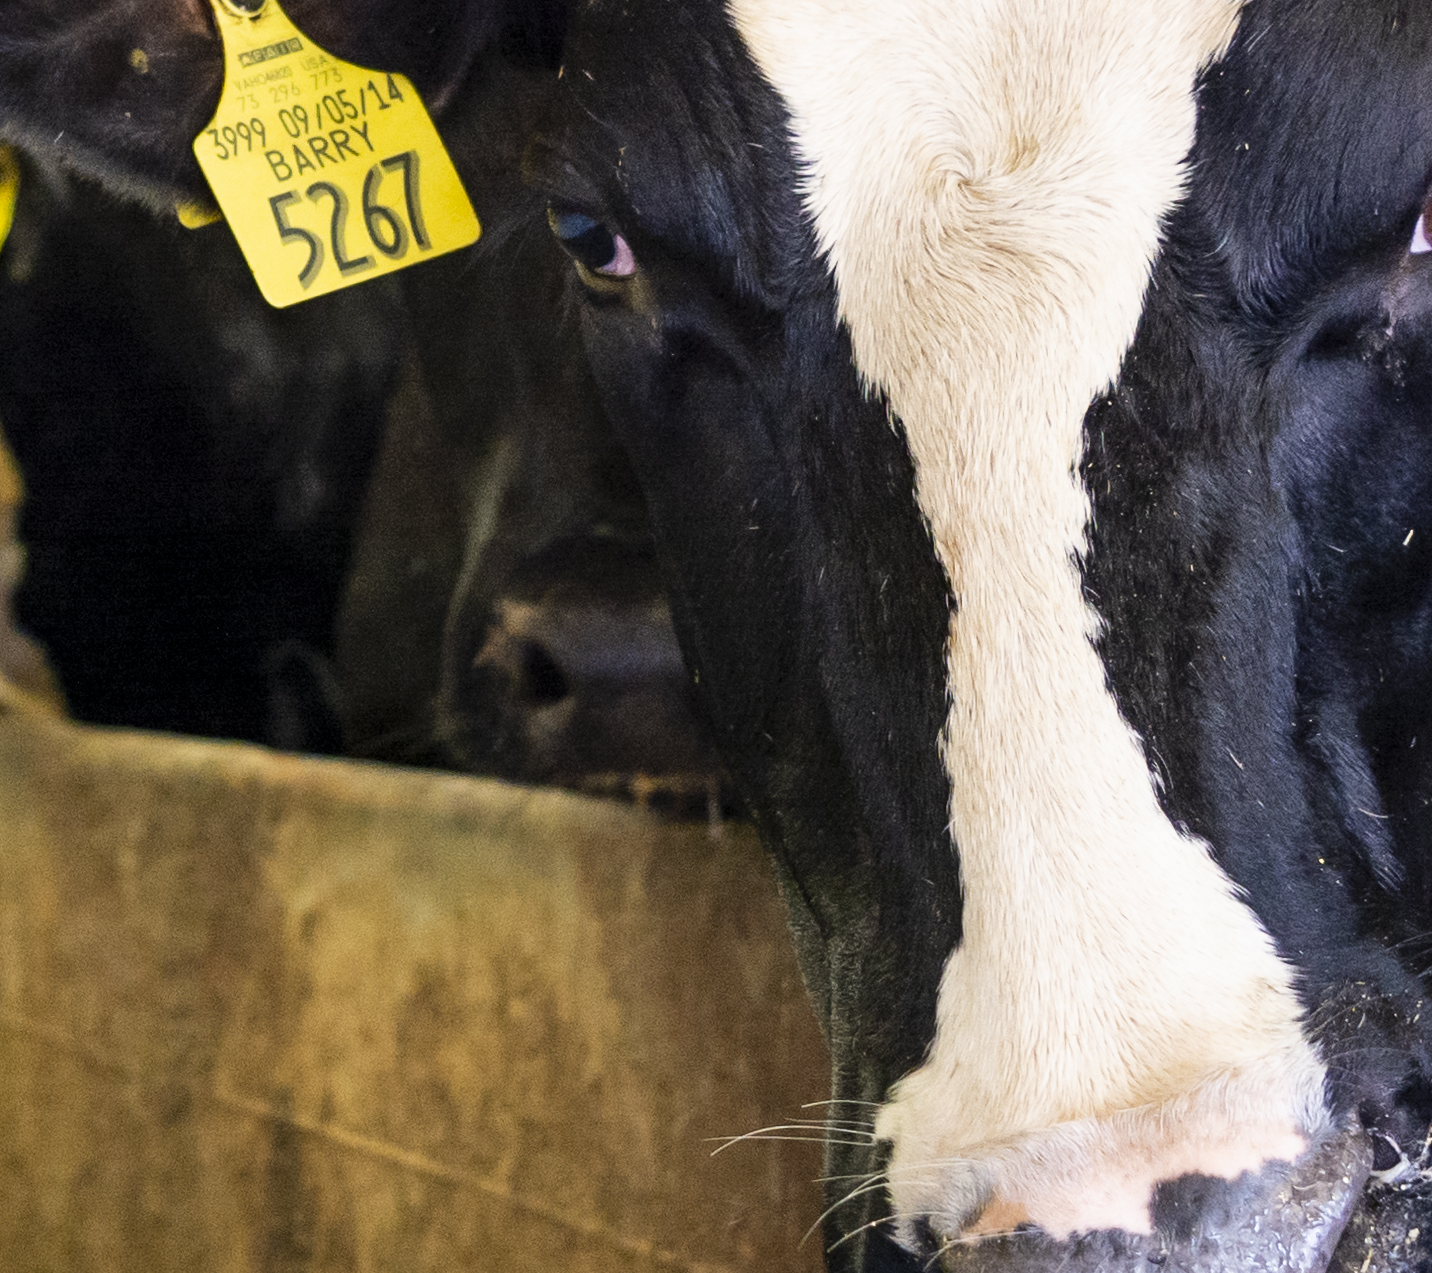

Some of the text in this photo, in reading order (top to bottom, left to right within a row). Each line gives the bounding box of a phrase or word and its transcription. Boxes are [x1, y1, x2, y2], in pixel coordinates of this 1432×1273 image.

[207, 73, 404, 160] 3999 09/05/14
[237, 66, 343, 112] 73 296 773
[265, 121, 374, 182] BARRY
[267, 149, 433, 291] 5267
